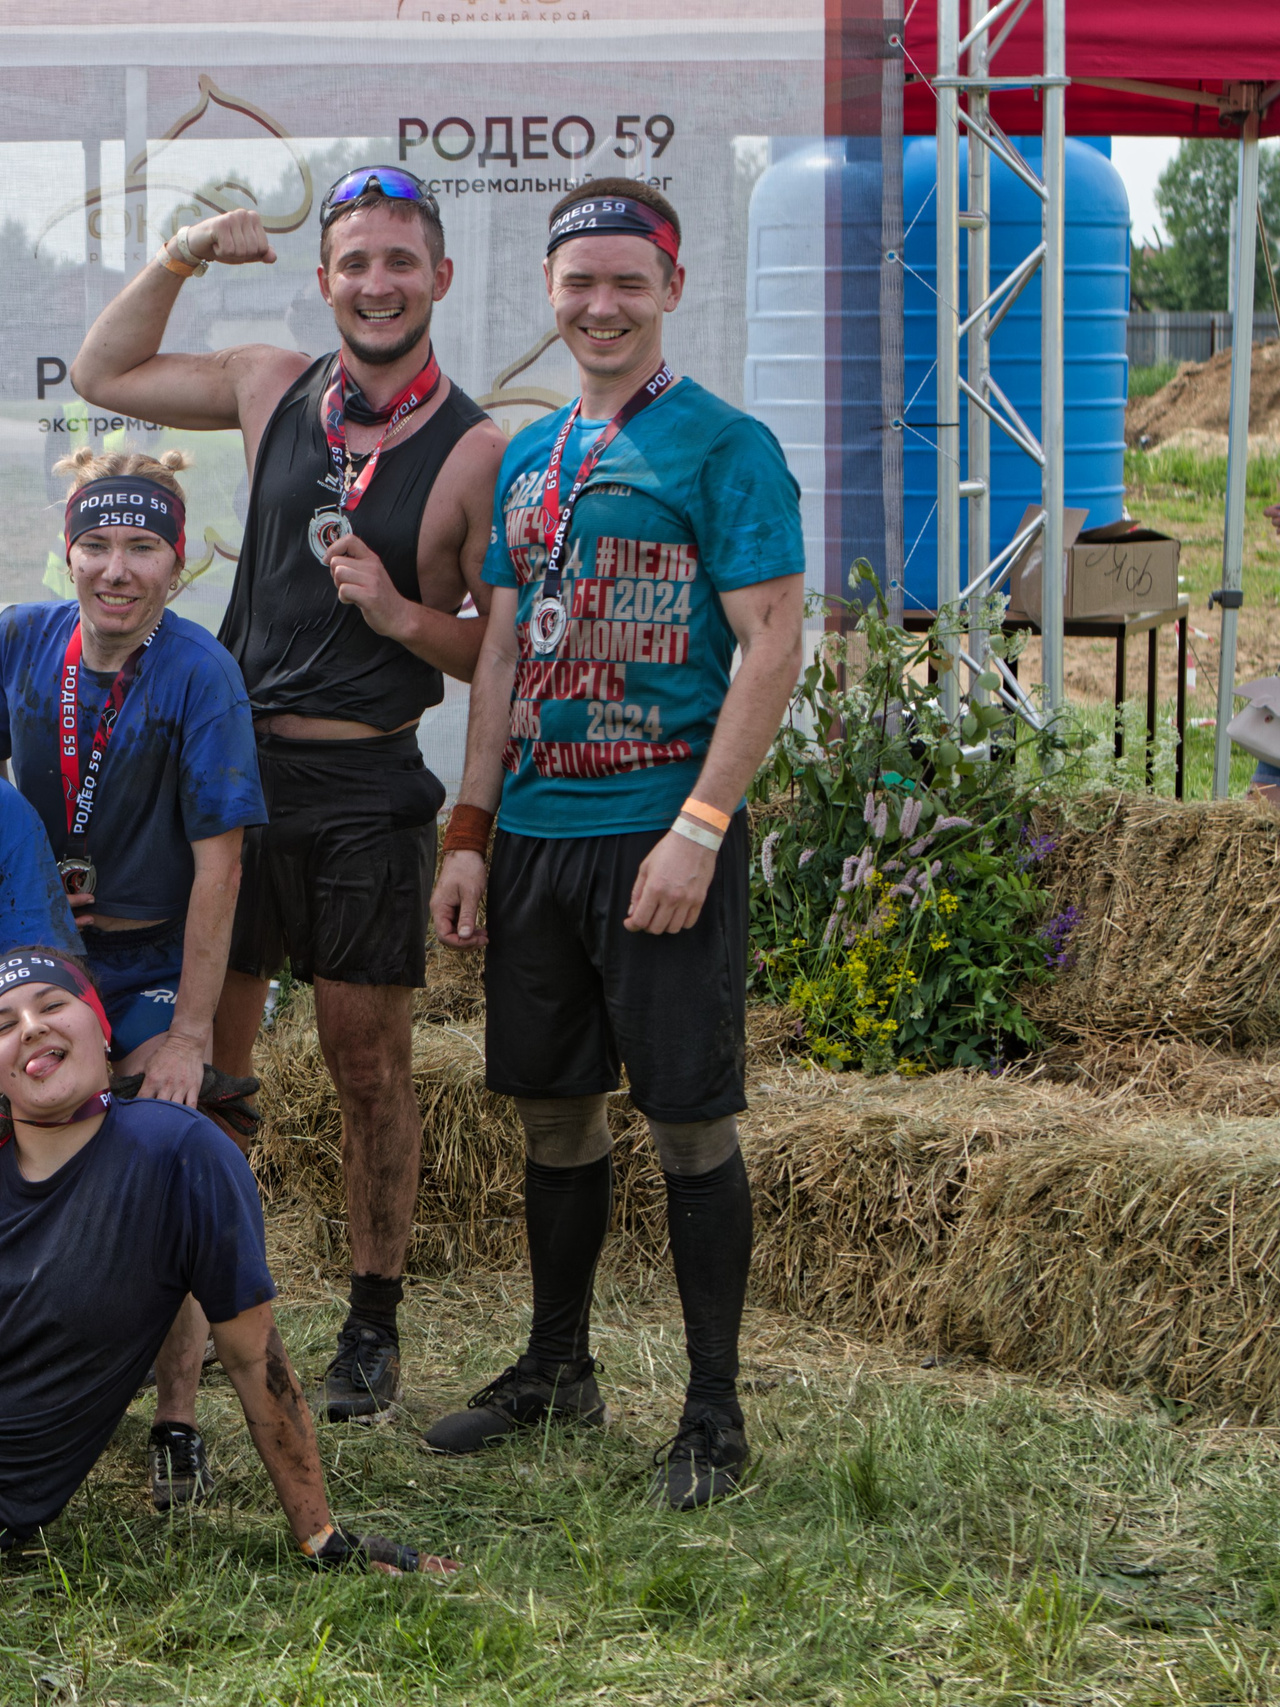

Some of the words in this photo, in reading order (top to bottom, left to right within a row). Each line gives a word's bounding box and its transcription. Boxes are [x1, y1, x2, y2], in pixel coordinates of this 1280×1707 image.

[422, 10, 530, 25] Пермский
[540, 9, 591, 24] край
[399, 114, 596, 169] РОДЕО
[613, 114, 675, 159] 59
[602, 202, 626, 213] 59
[645, 366, 674, 396] РОД
[331, 446, 343, 465] 59
[546, 469, 558, 490] 59
[80, 493, 144, 512] РОДЕО
[150, 497, 168, 515] 59
[99, 512, 146, 526] 2569
[548, 508, 572, 571] РОДЕО
[595, 536, 699, 582] #ЦЕЛЬ
[60, 665, 77, 729] РОДЕО
[586, 701, 663, 742] 2024
[63, 735, 76, 757] 59
[73, 774, 96, 834] РОДЕО
[89, 750, 102, 773] 59
[30, 957, 55, 968] 59
